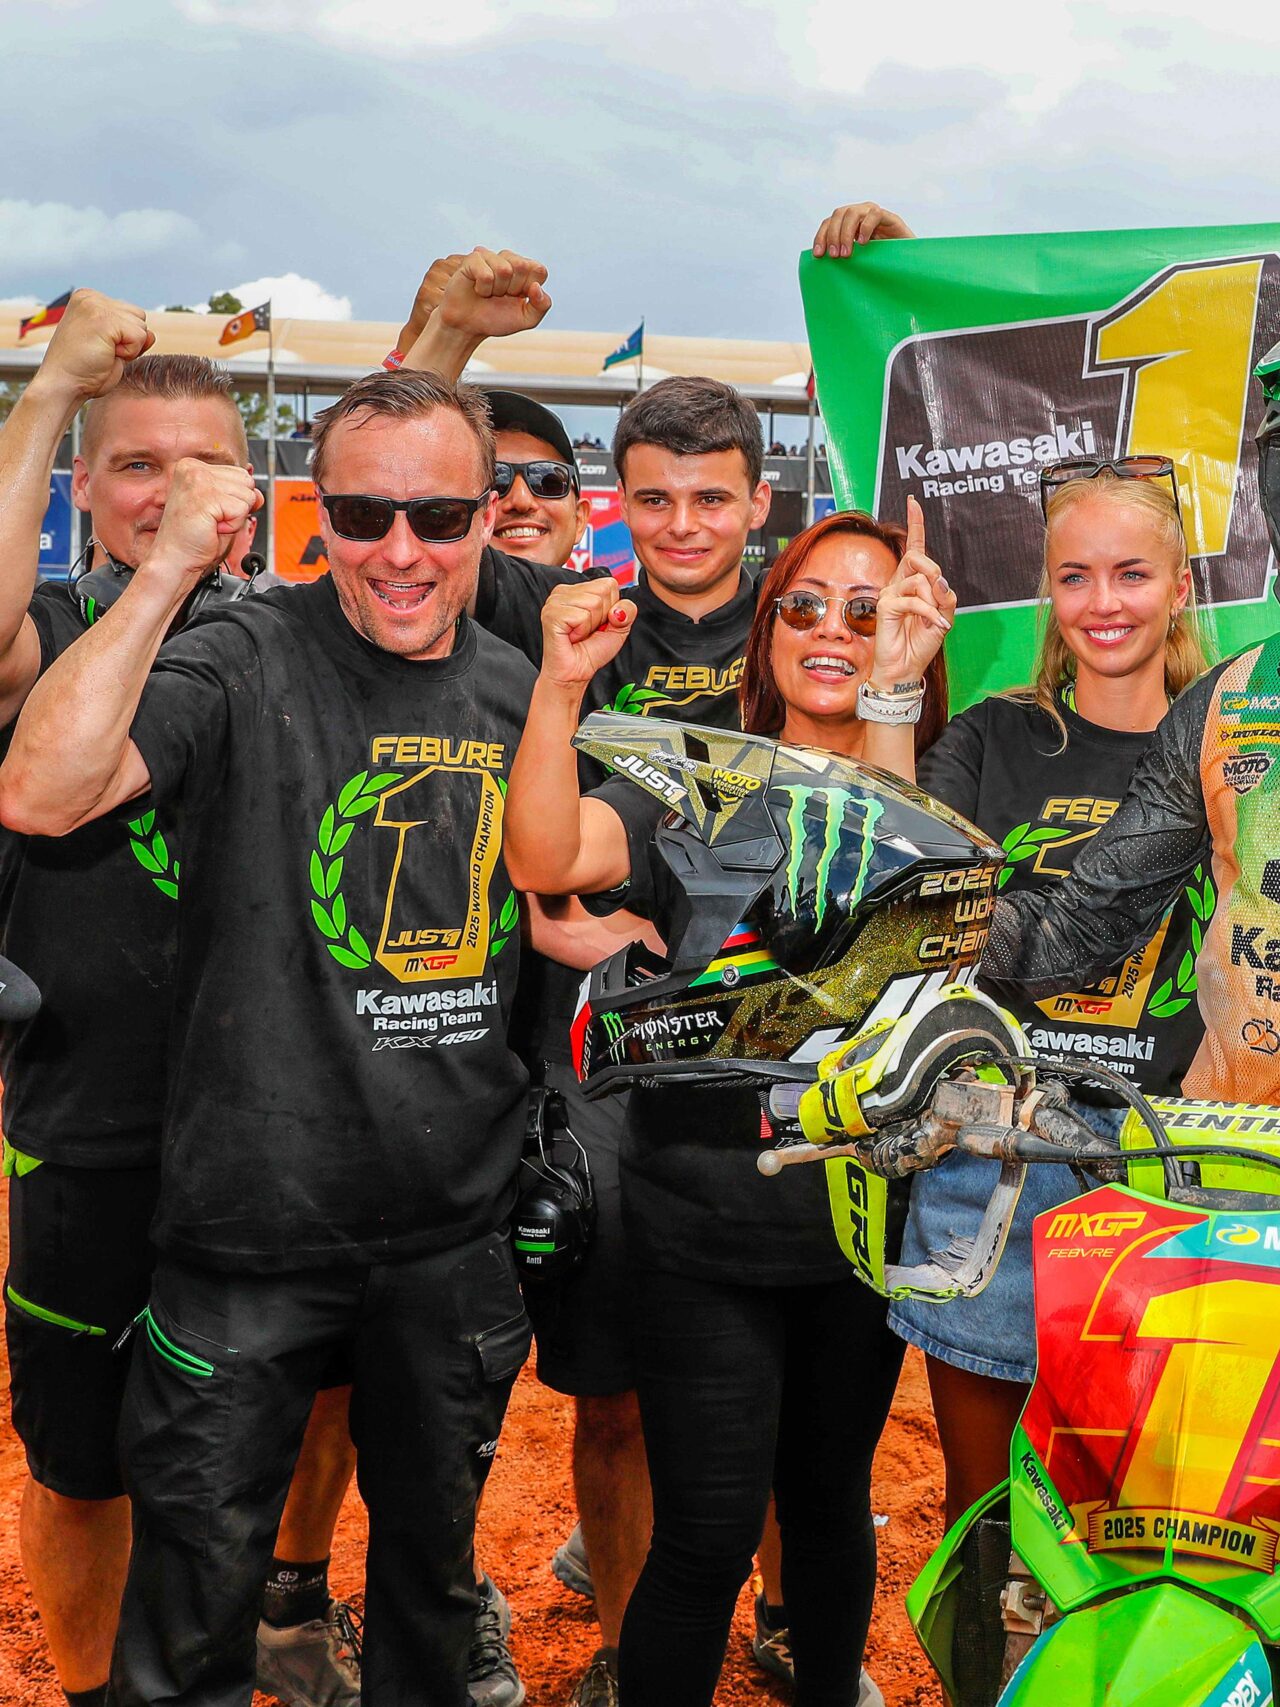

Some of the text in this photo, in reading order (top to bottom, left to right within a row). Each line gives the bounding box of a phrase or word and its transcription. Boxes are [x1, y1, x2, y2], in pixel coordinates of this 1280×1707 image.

[896, 421, 1096, 479] Kawasaki
[923, 475, 1004, 498] Racing
[1223, 757, 1270, 777] MOTO
[613, 754, 688, 805] JUST1
[713, 768, 762, 791] MOTO
[466, 790, 495, 949] 2025 WORLD CHAMPION
[920, 867, 995, 897] 2025
[387, 928, 462, 947] JUST1
[404, 955, 458, 974] MXGP
[1121, 966, 1140, 1000] 2025
[356, 980, 498, 1015] Kawasaki
[1054, 997, 1113, 1015] MXGP
[373, 1012, 482, 1031] Racing Team
[438, 1028, 490, 1045] 450
[646, 1034, 712, 1052] ENERGY
[518, 1226, 550, 1234] Kawasaki
[1045, 1211, 1147, 1238] MXGP
[1048, 1247, 1116, 1259] FEBVRE
[1019, 1452, 1068, 1531] Kawasaki
[1103, 1516, 1257, 1557] 2025 CHAMPION
